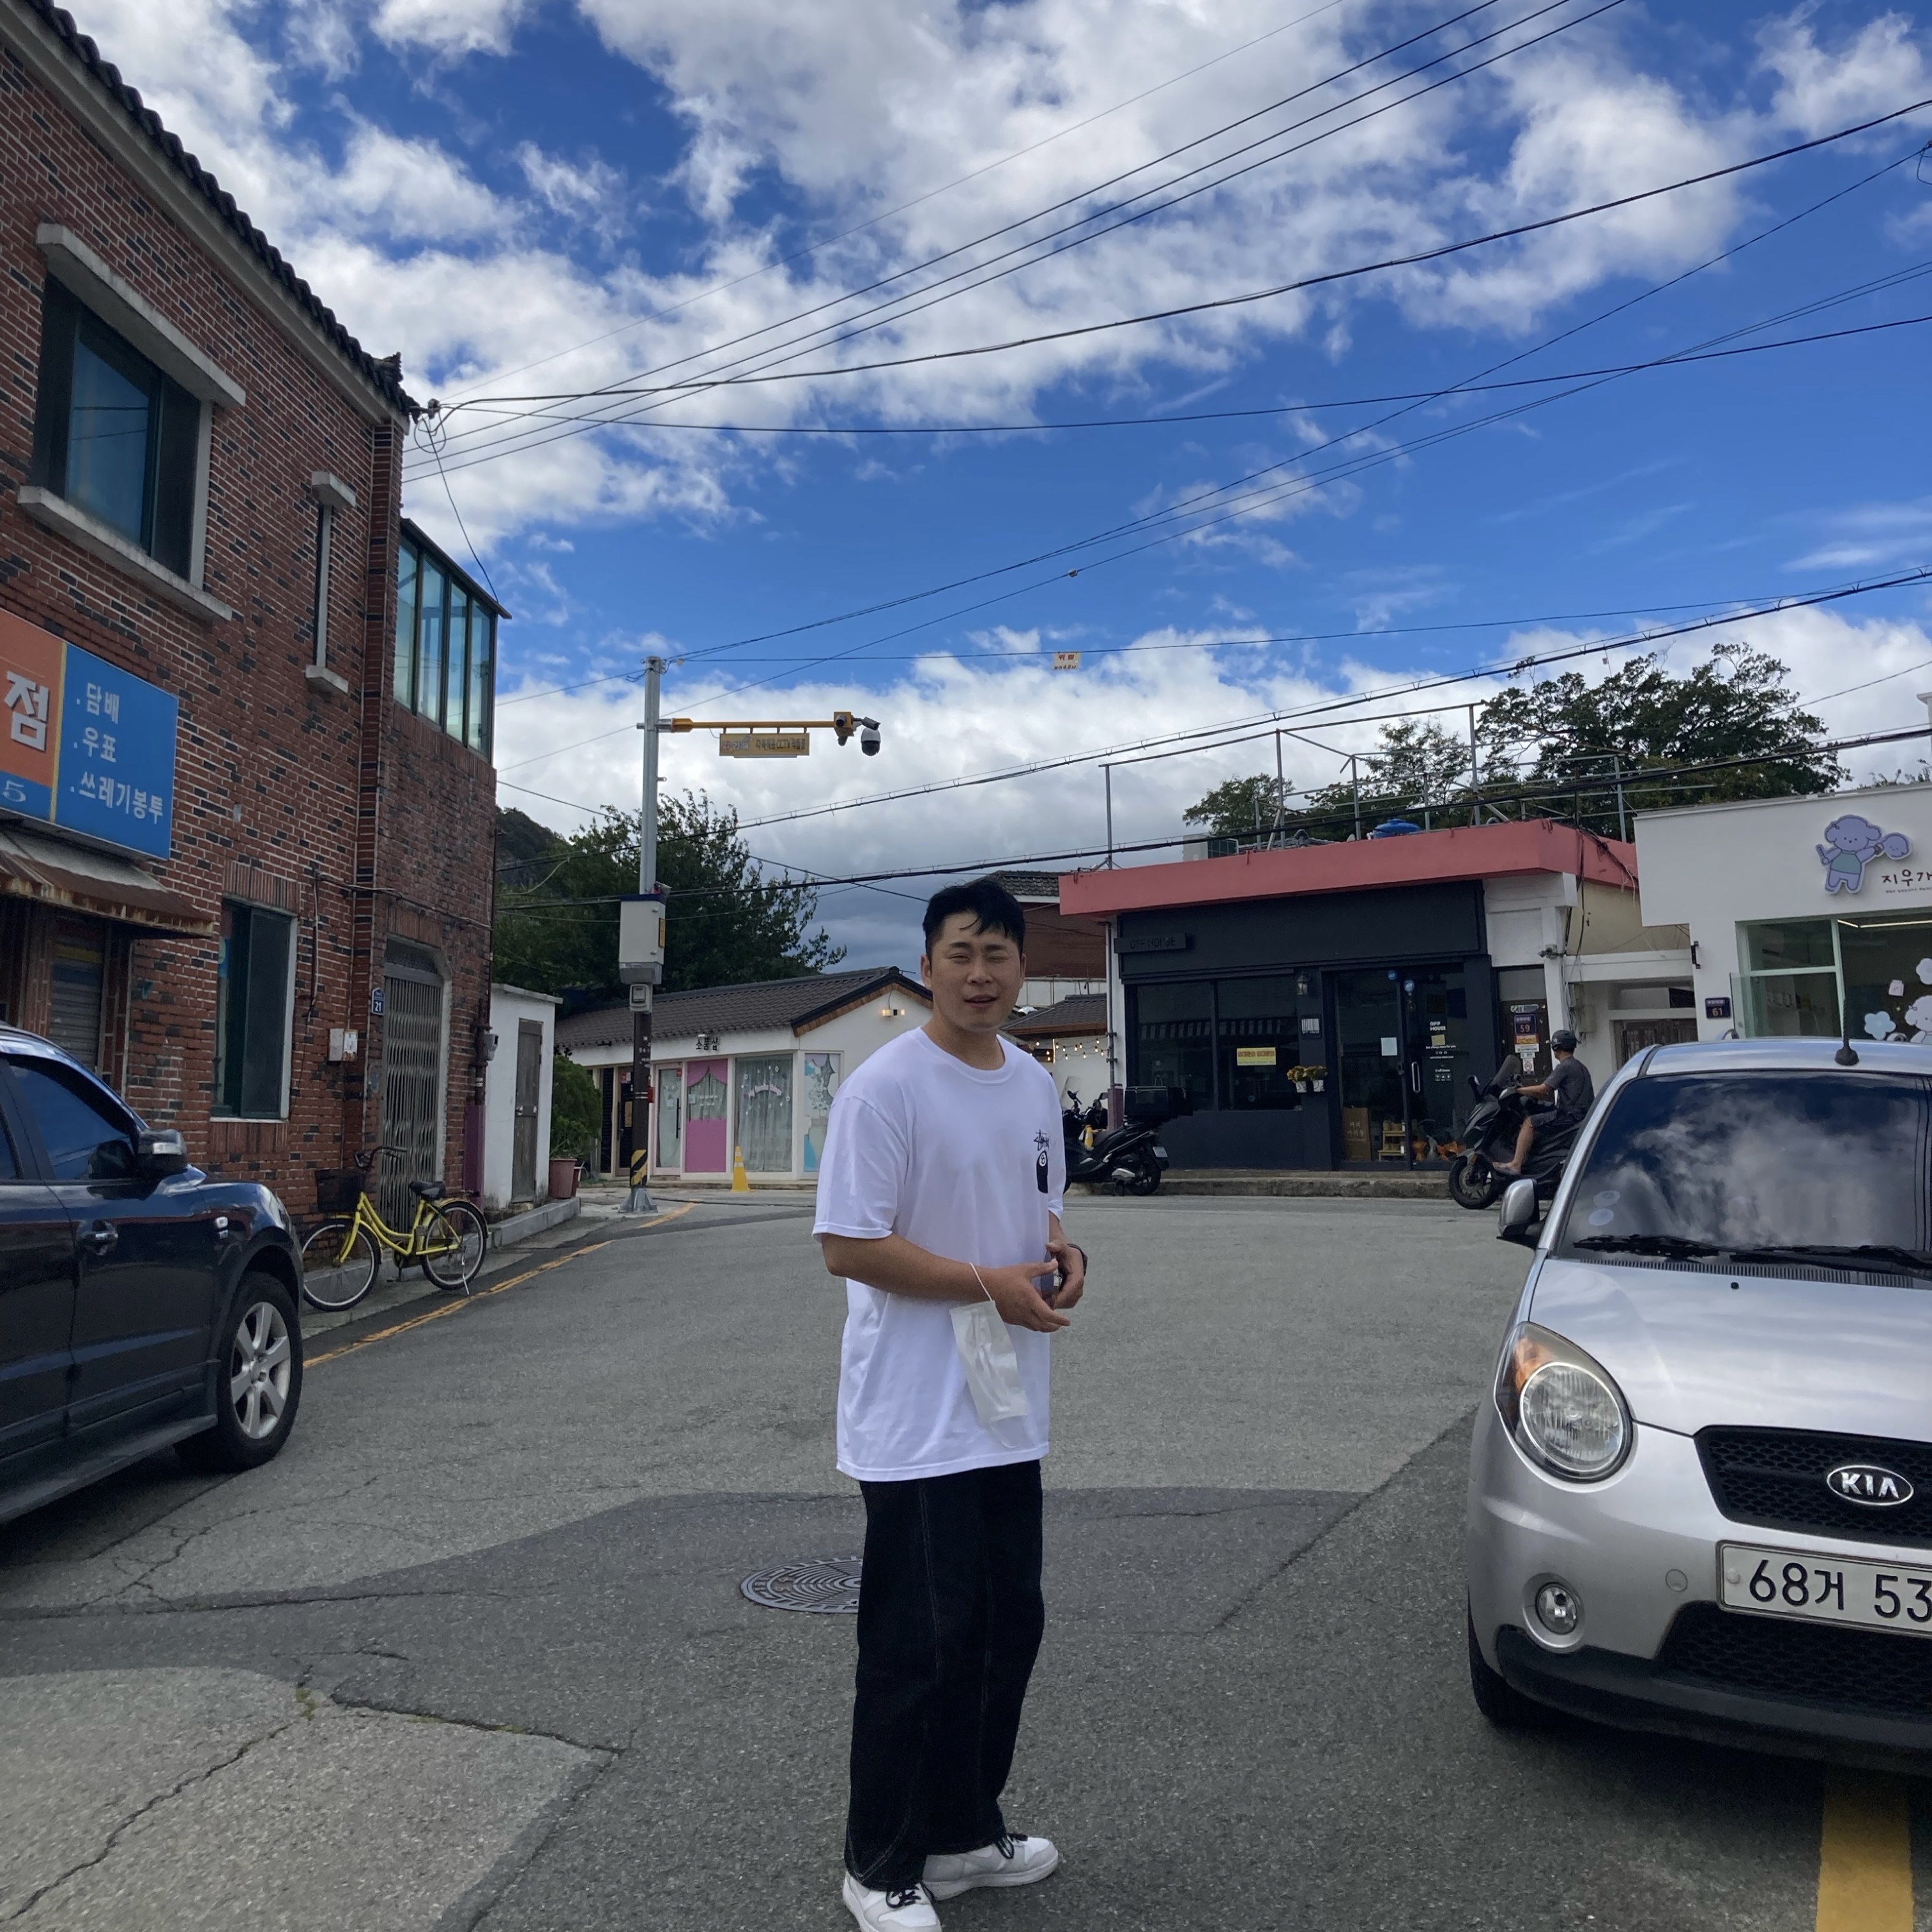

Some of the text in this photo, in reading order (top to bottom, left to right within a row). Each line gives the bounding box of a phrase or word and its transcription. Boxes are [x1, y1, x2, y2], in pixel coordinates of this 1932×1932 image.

[4, 671, 49, 751] 점
[87, 682, 119, 724] 담배
[82, 727, 116, 763] 우표
[79, 772, 163, 824] 쓰레기봉투
[374, 1001, 381, 1012] 21
[1712, 1008, 1723, 1016] 61
[1521, 1024, 1530, 1032] 59
[1840, 1471, 1900, 1499] KIA
[1749, 1559, 1932, 1623] 68거 53
